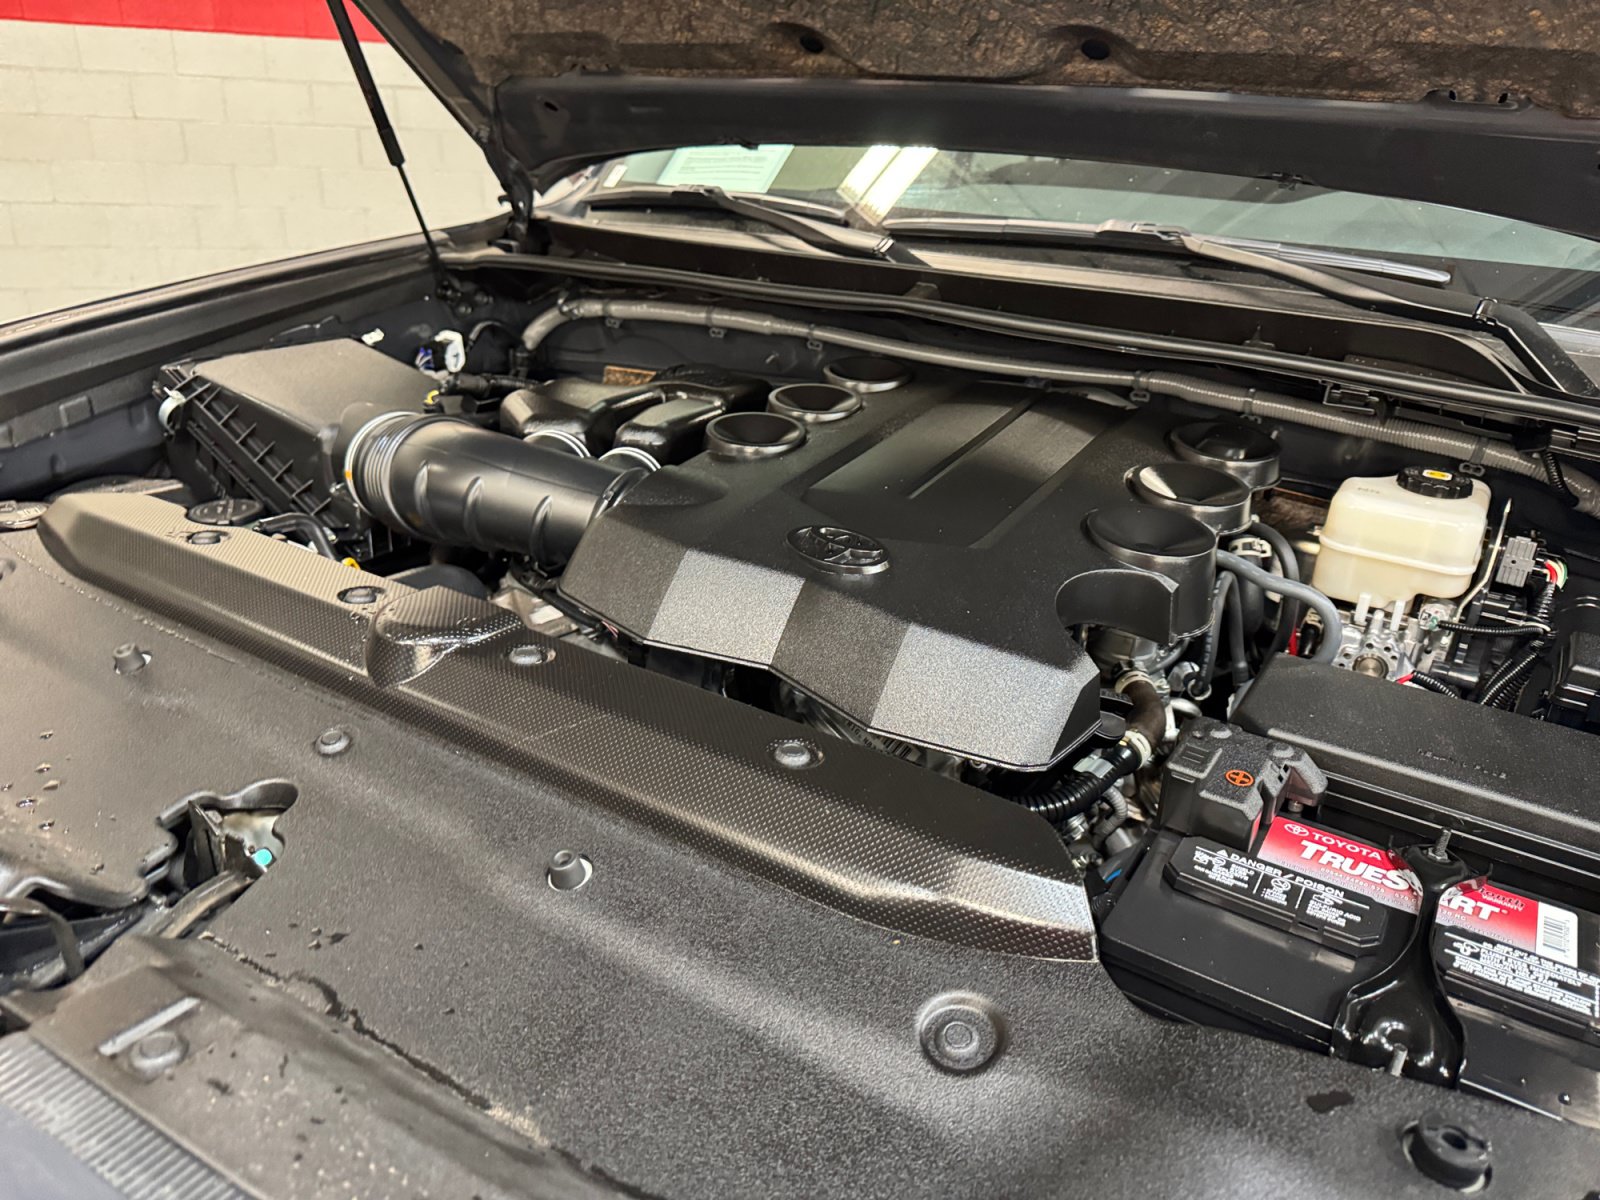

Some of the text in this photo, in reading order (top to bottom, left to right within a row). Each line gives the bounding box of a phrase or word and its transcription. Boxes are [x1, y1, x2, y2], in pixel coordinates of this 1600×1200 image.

[1312, 832, 1382, 860] TOYOTA
[1231, 853, 1282, 877] DANGER
[1295, 875, 1344, 898] POISON
